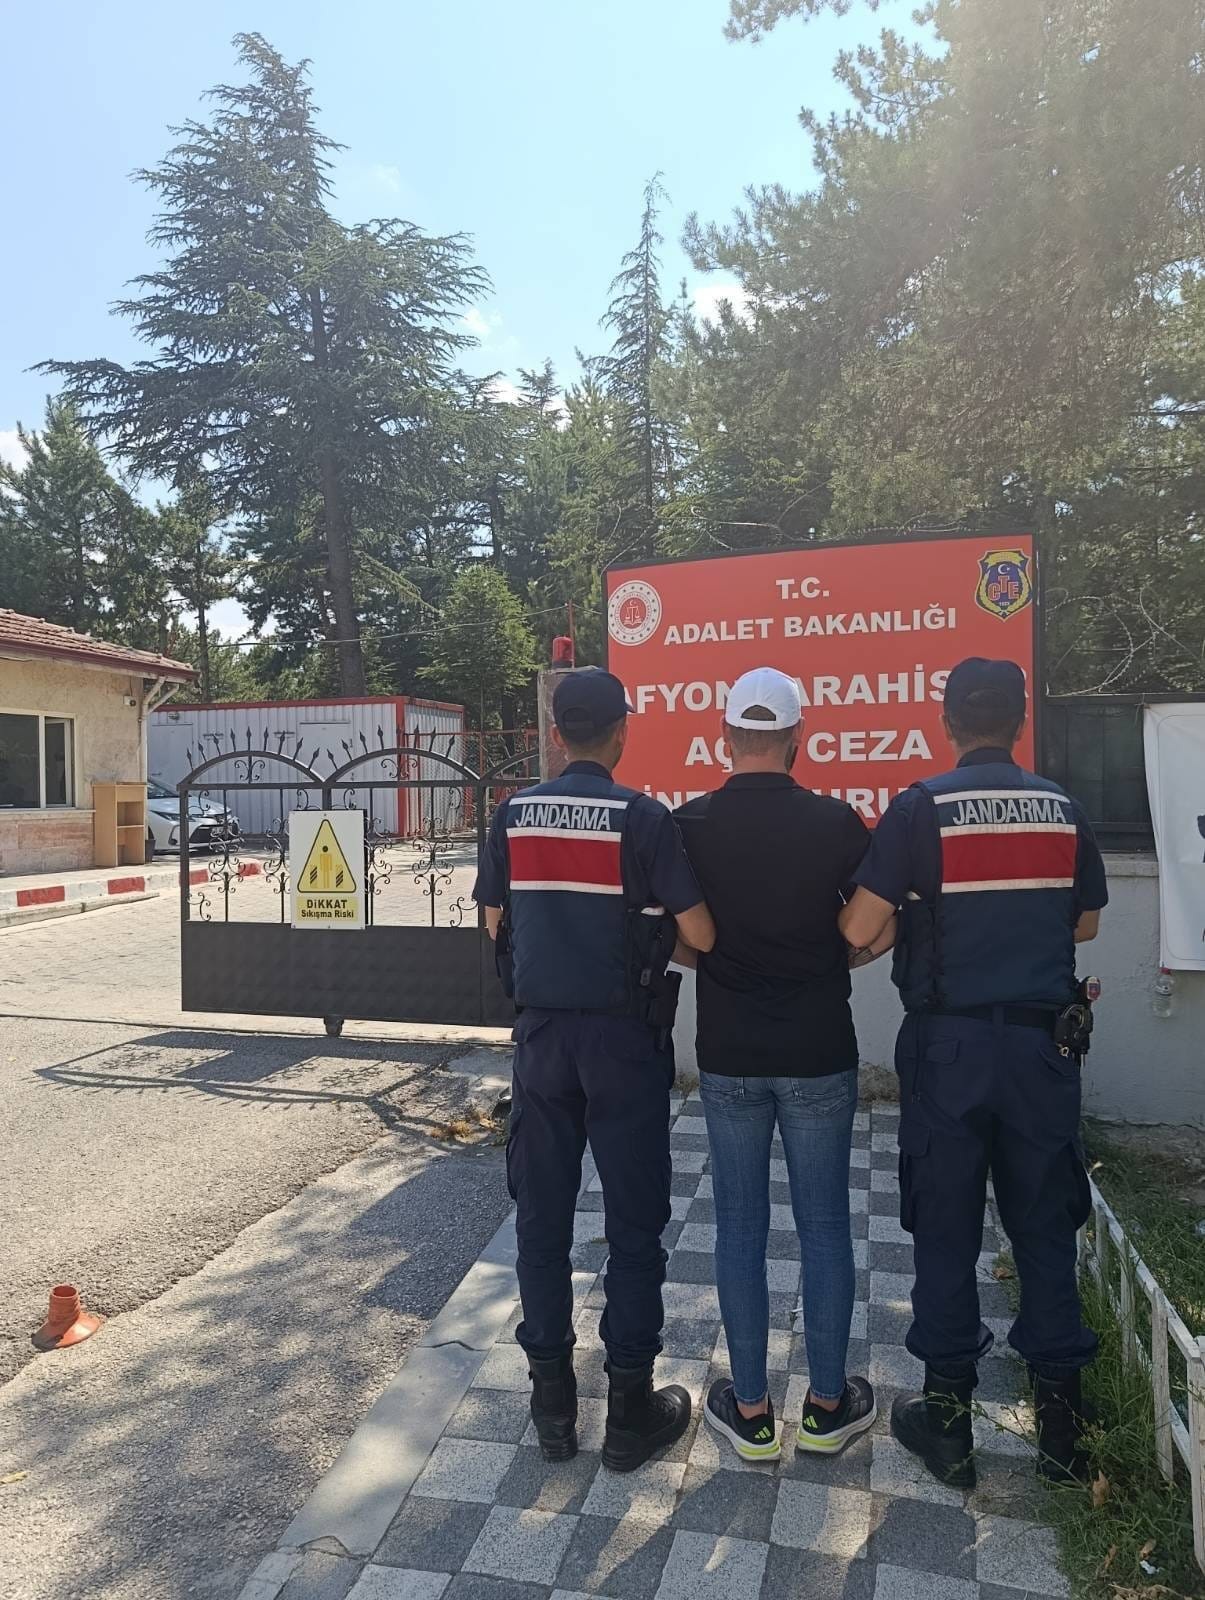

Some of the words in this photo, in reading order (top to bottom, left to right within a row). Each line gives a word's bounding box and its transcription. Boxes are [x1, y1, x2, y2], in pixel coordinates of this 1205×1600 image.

[775, 576, 830, 600] T.C.
[663, 618, 774, 645] ADALET
[784, 602, 957, 637] BAKANLIĞI
[806, 729, 933, 763] CEZA
[515, 804, 611, 831] JANDARMA
[952, 798, 1067, 826] JANDARMA
[301, 909, 332, 919] Sıkışma
[334, 909, 354, 918] Riski
